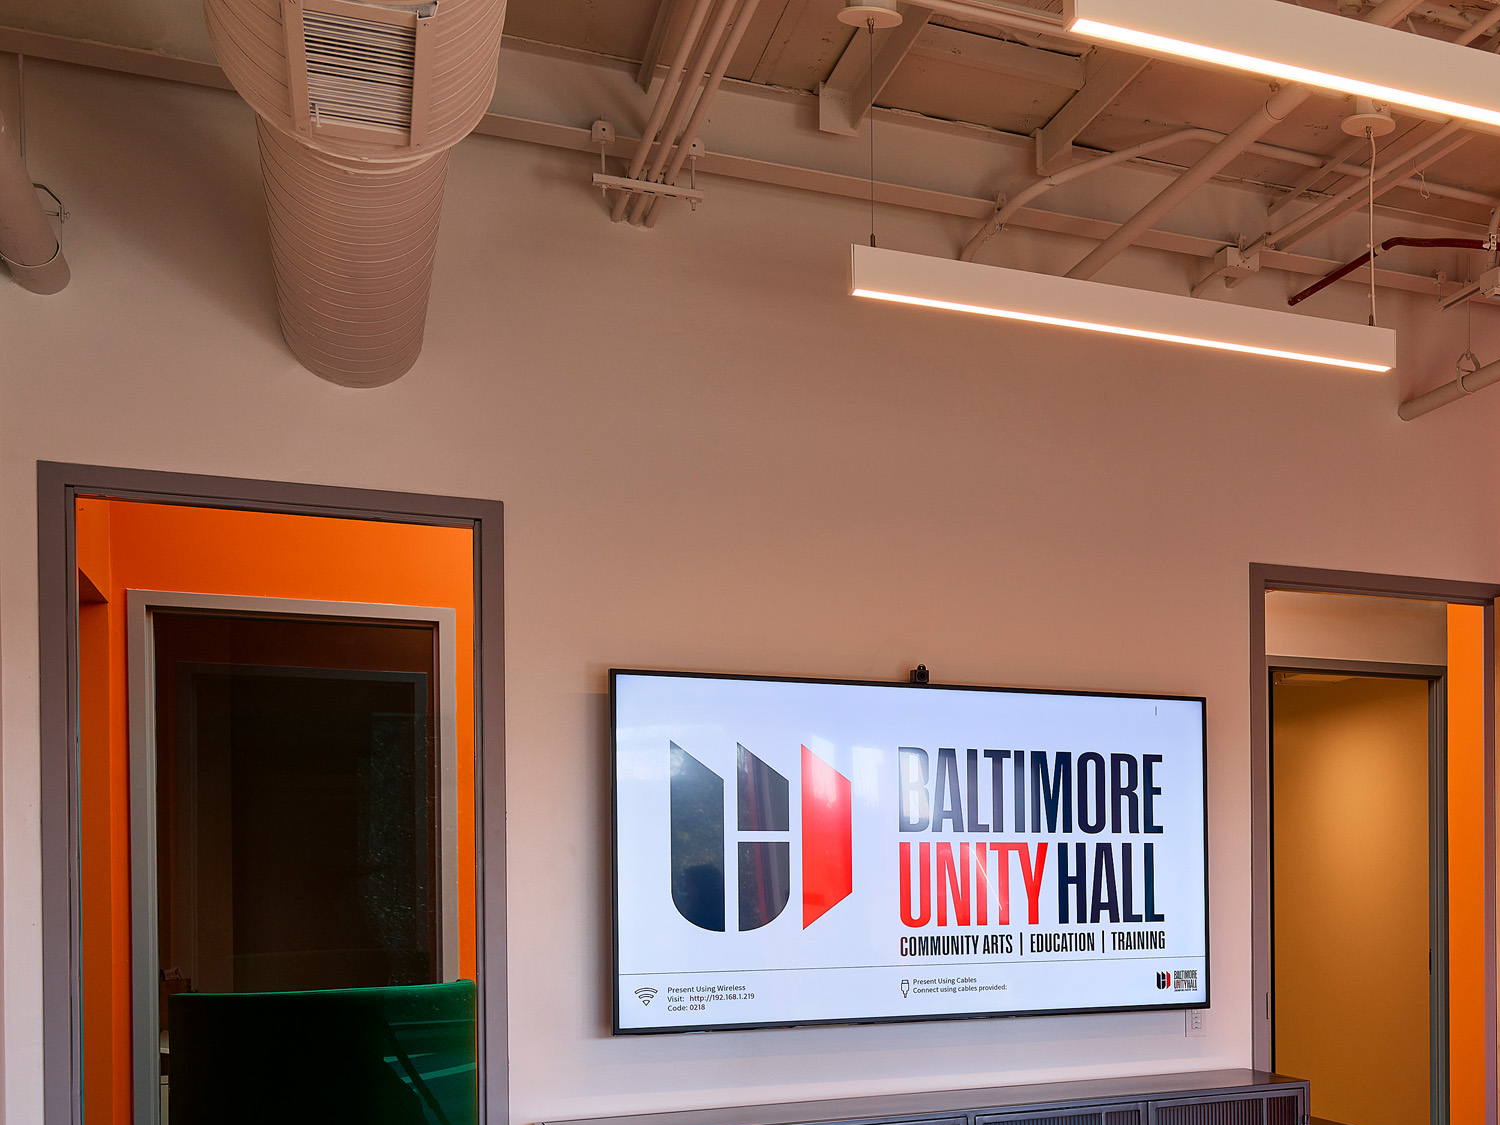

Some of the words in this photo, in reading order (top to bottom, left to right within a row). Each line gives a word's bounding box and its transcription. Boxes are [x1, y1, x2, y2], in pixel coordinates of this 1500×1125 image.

[898, 746, 1164, 834] BALTIMORE
[899, 842, 1048, 928] UNITY
[1057, 842, 1165, 924] HALL
[900, 935, 979, 957] COMMUNITY
[982, 933, 1013, 955] ARTS
[1030, 932, 1095, 953] EDUCATION
[1111, 930, 1166, 951] TRAINING
[689, 993, 755, 1002] http://192.168.1.219
[979, 984, 1007, 992] provided:
